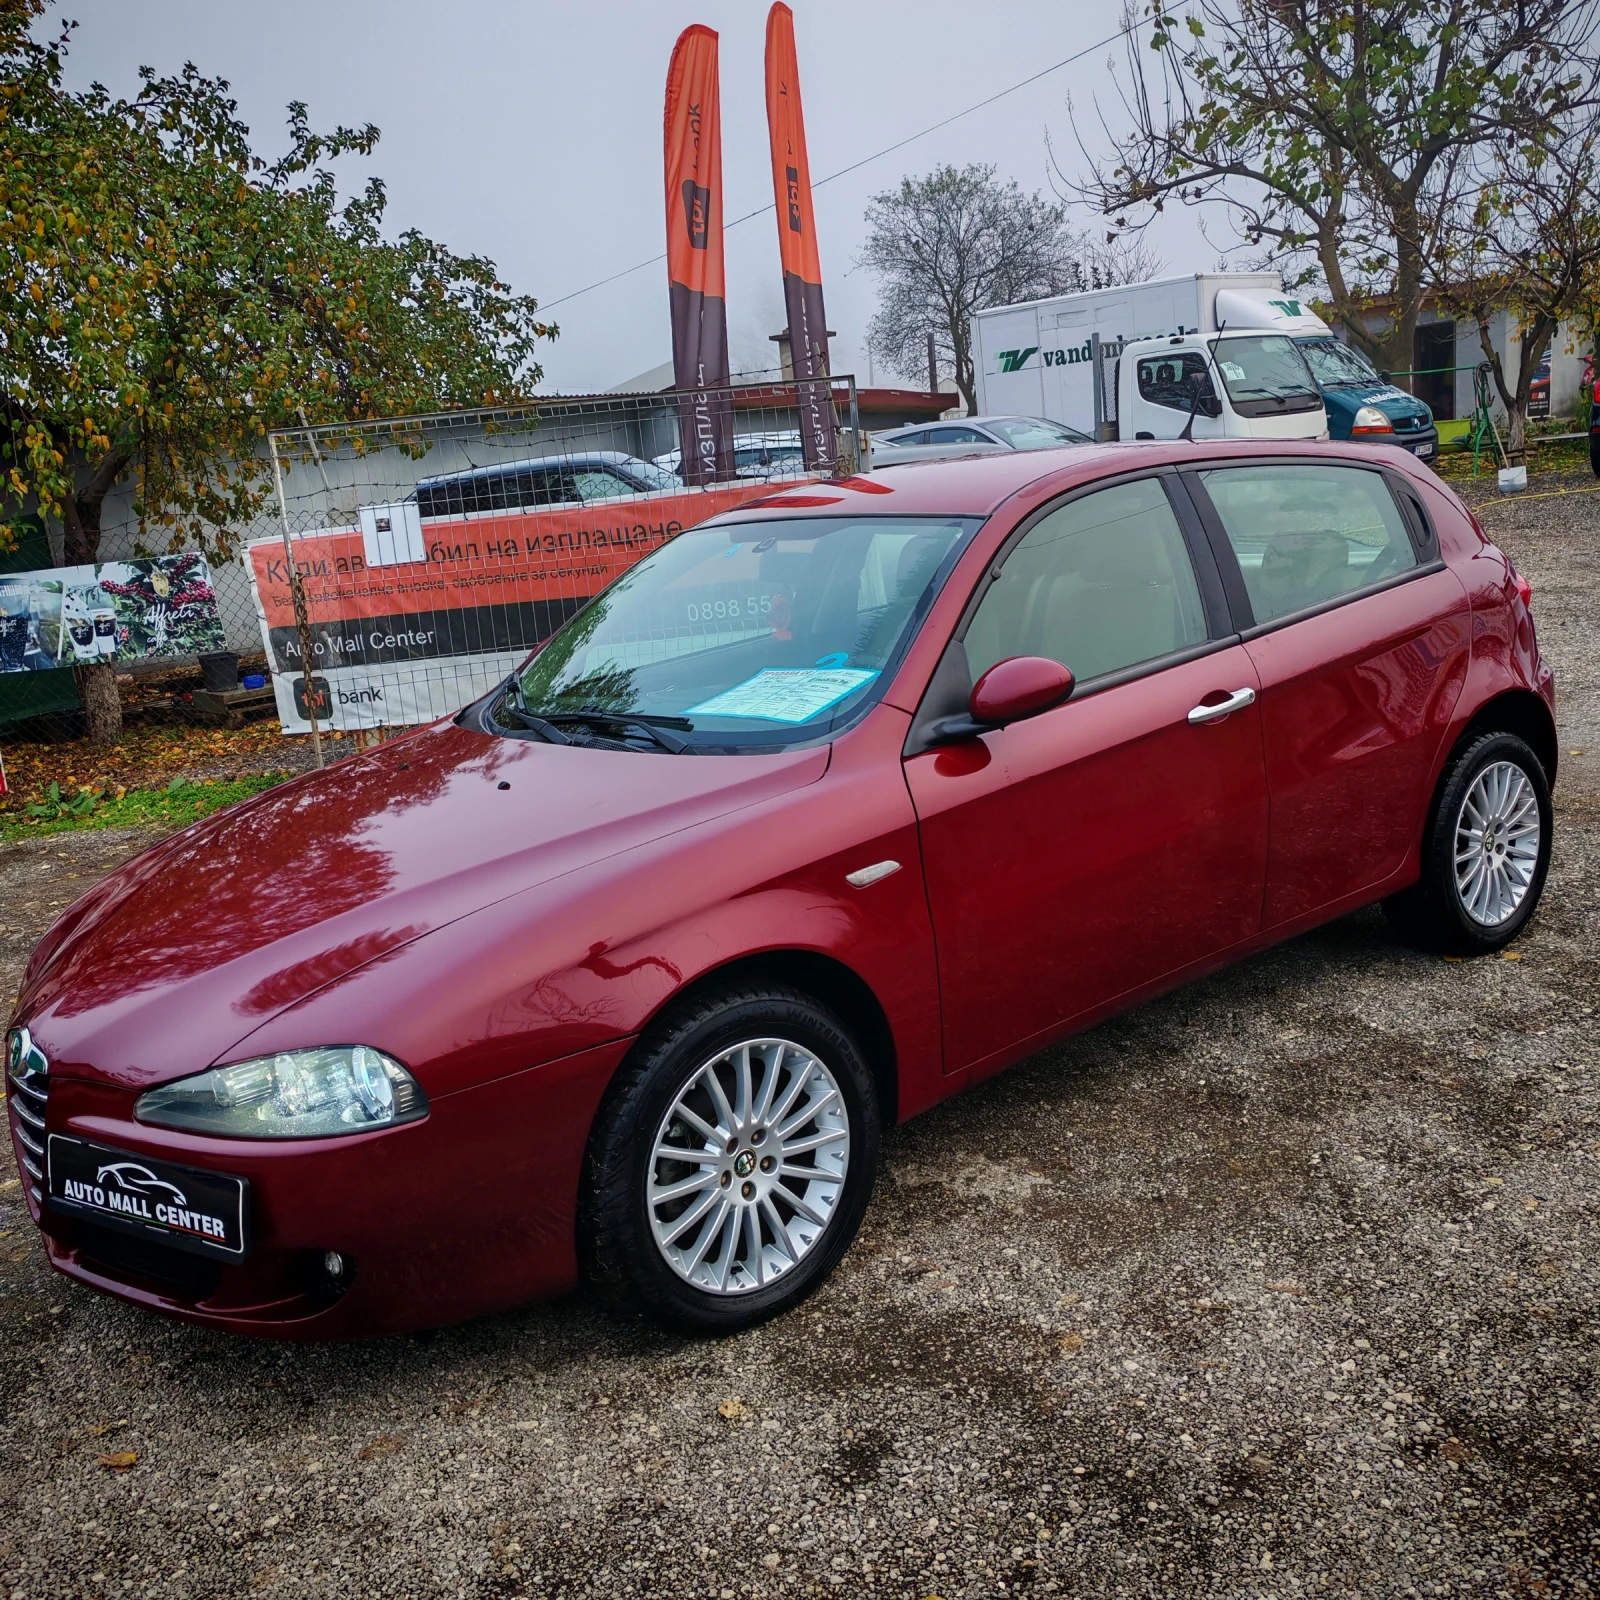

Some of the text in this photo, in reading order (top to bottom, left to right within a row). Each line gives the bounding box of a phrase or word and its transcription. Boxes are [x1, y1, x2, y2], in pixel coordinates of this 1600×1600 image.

[336, 541, 480, 574] авбил
[486, 539, 519, 559] на
[525, 520, 683, 555] изплащане
[305, 585, 394, 604] ървоначална
[452, 570, 528, 589] одобрение
[531, 568, 547, 581] за
[550, 563, 608, 580] секунди
[687, 594, 778, 621] 0898 55
[285, 629, 435, 658] Auo Mall Center
[337, 685, 384, 704] bank
[64, 1179, 226, 1239] AUTO MALL CENTER
